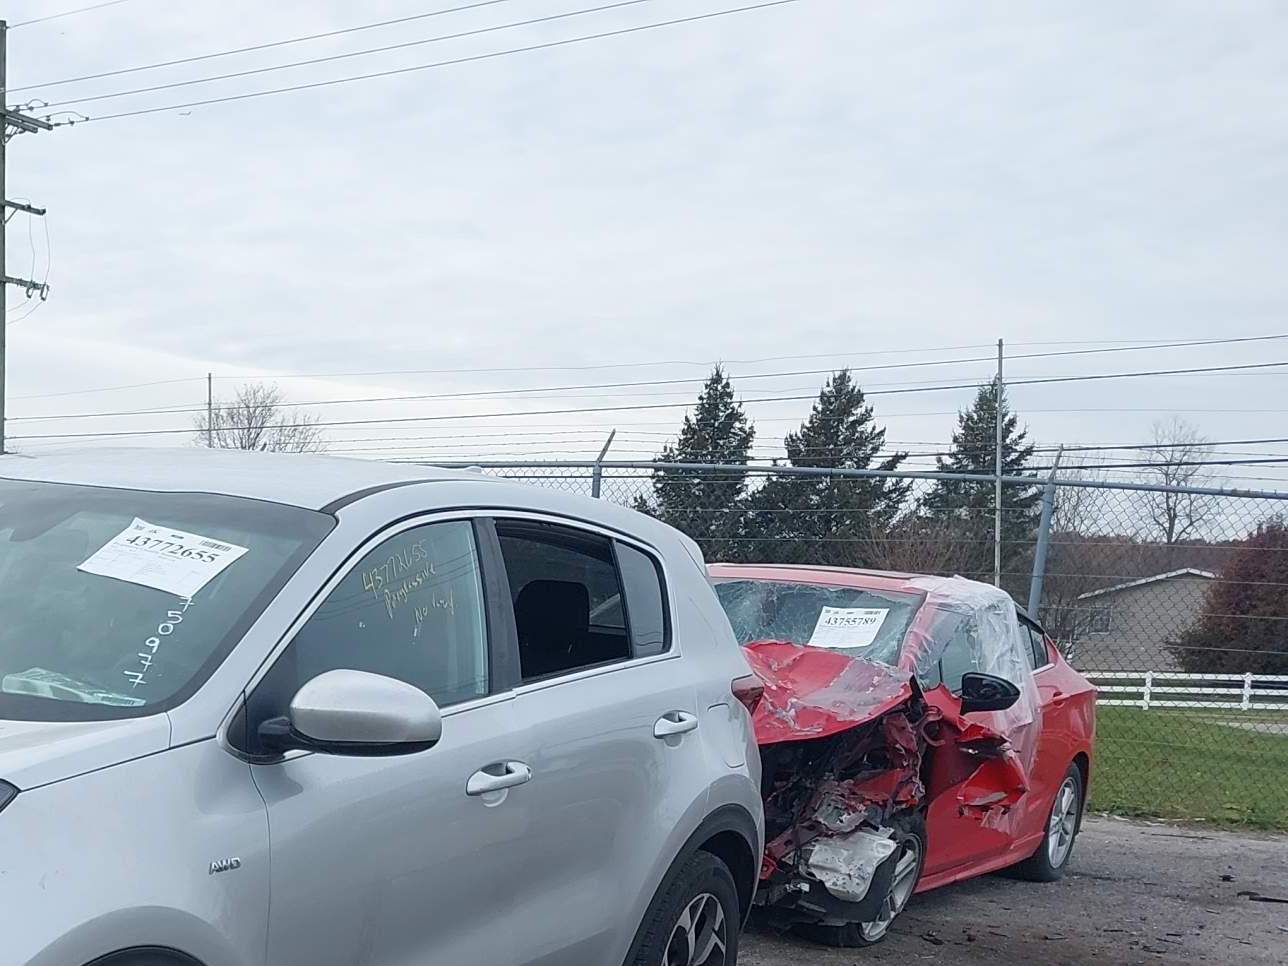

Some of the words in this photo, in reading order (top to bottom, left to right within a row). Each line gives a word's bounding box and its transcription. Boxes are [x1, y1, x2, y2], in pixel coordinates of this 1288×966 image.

[125, 533, 220, 563] 43772655
[824, 616, 877, 627] 43755789
[208, 856, 242, 876] AWD
